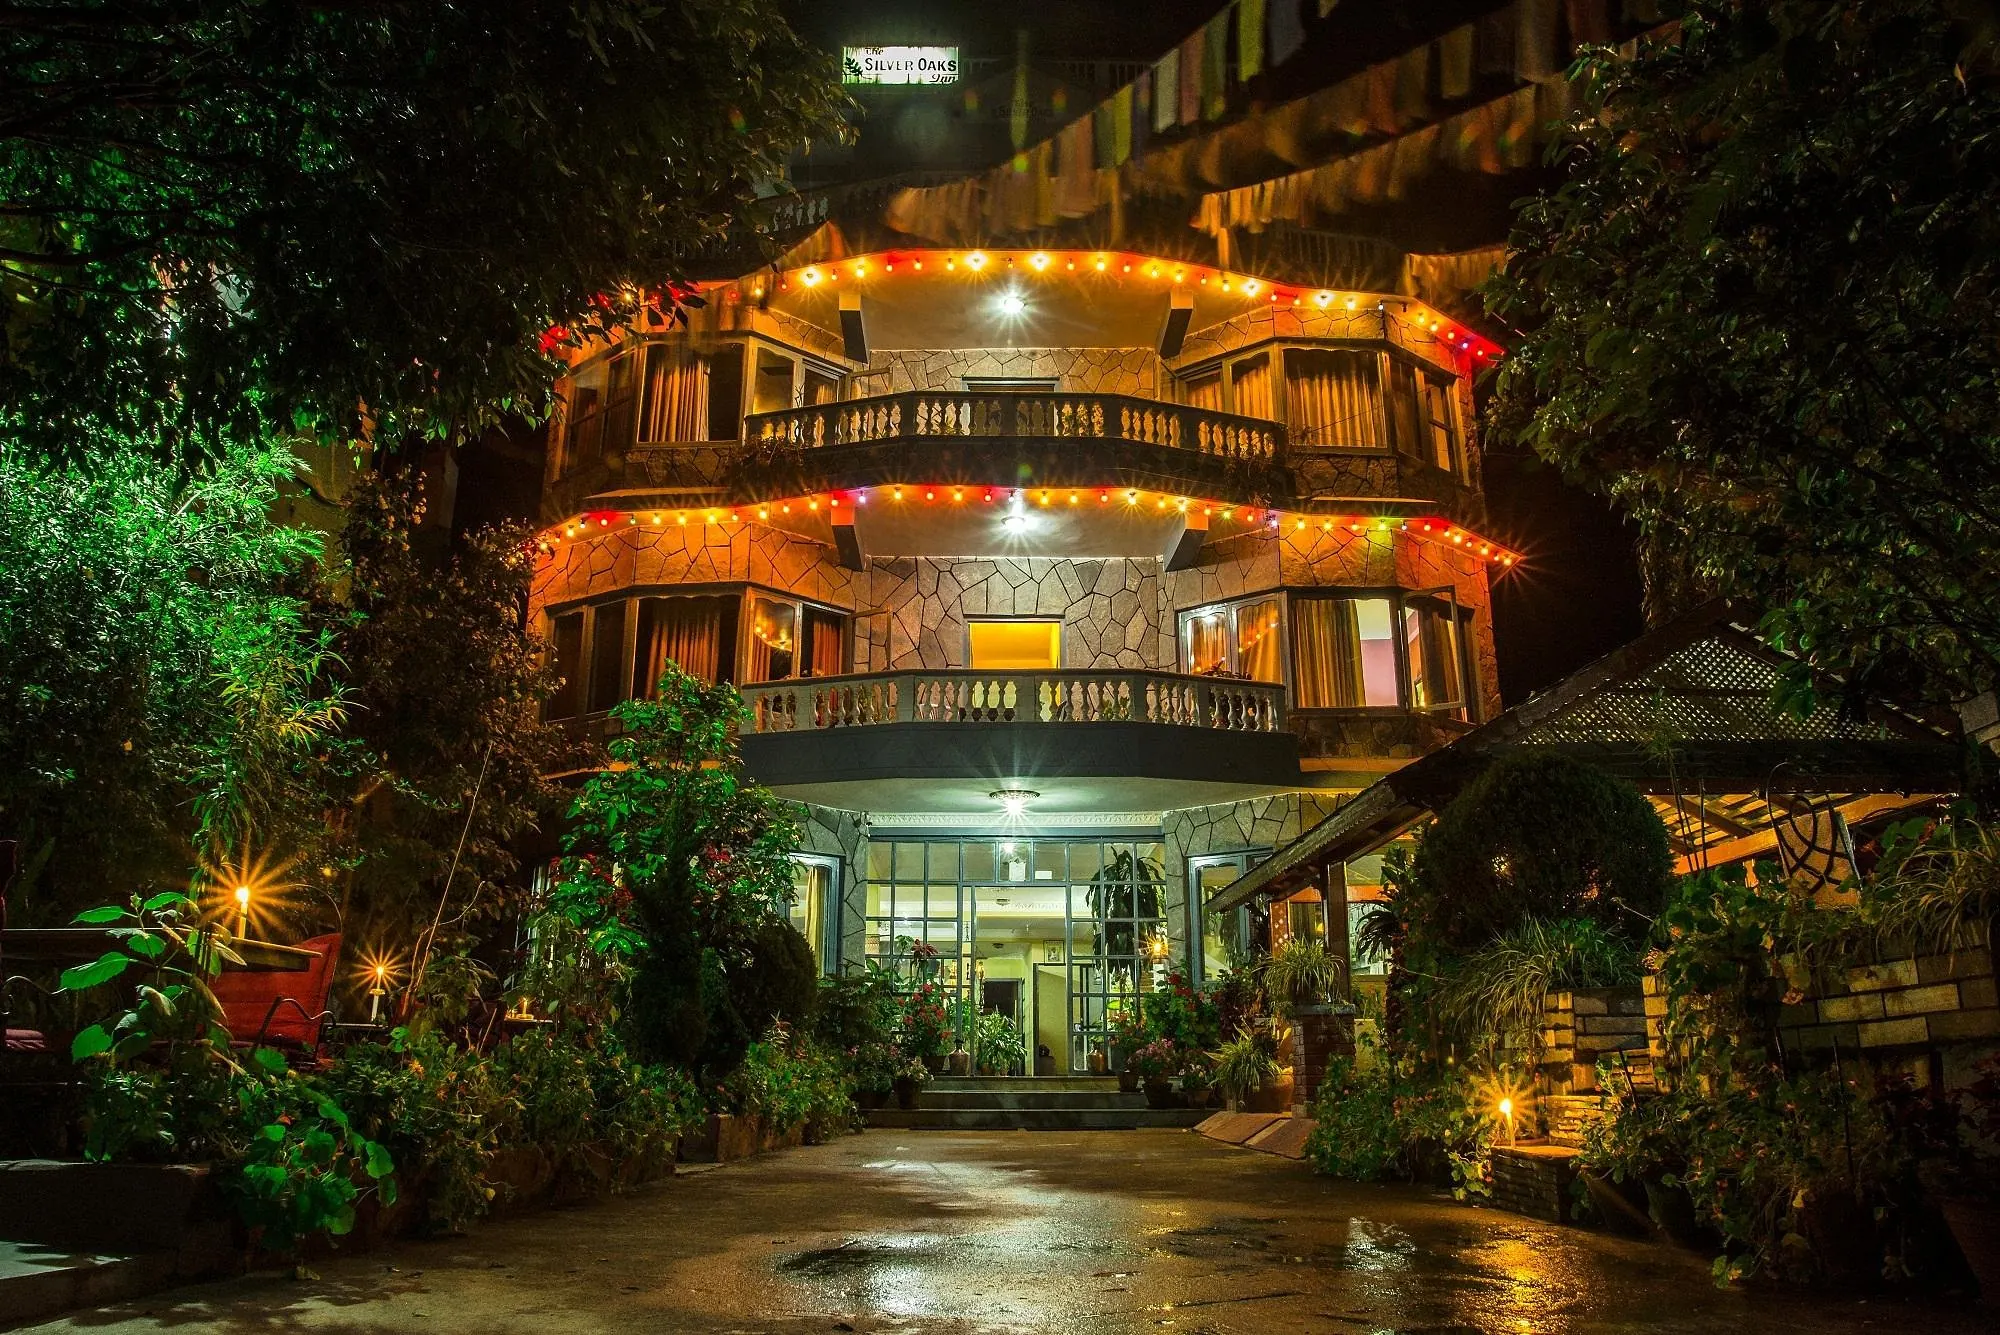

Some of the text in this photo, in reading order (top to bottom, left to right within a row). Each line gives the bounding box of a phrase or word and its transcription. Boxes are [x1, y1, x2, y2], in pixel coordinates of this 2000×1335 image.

[865, 58, 957, 71] SILVER OAKS
[929, 74, 956, 83] Inn
